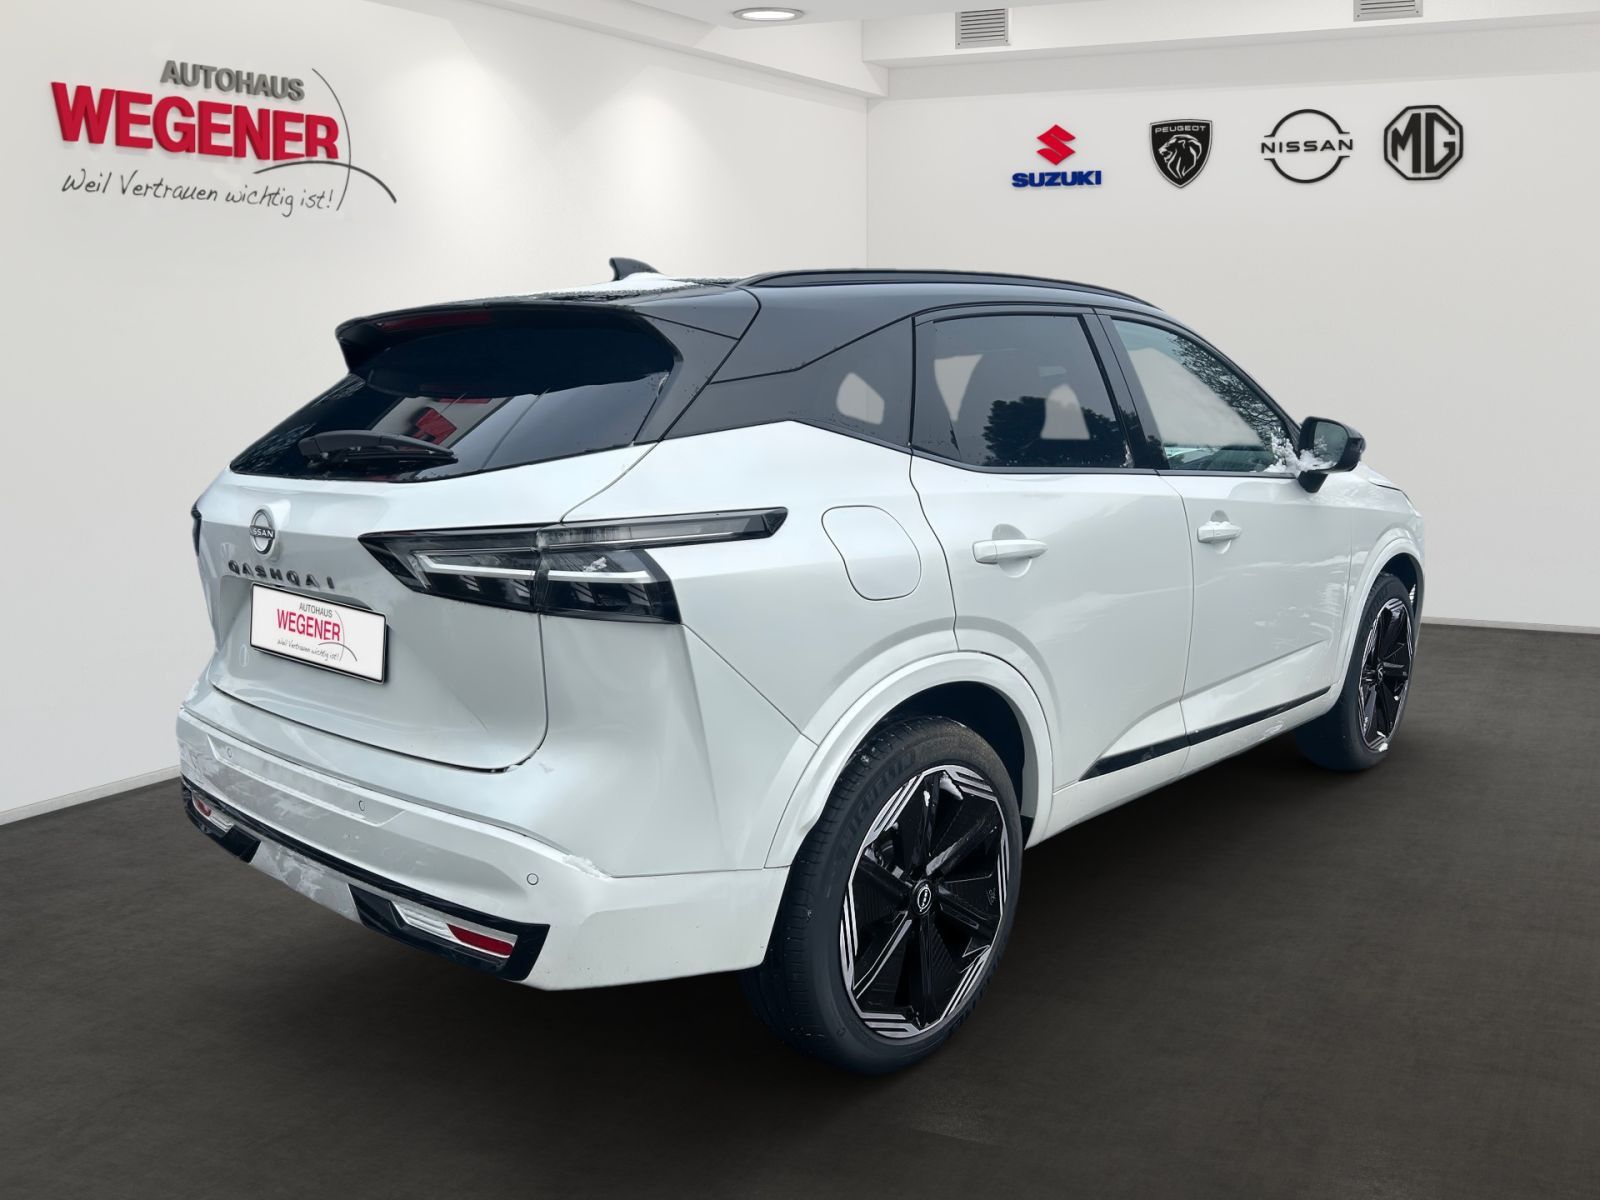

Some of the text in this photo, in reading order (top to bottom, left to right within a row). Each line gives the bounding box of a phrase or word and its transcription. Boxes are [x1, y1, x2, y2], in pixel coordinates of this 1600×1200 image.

[160, 60, 305, 101] AUTOHAUS
[51, 82, 340, 161] WEGENER
[1154, 124, 1207, 133] PEUGEOT
[1261, 138, 1354, 154] NISSAN
[1390, 112, 1457, 174] MG
[61, 168, 334, 218] Weil Vertrauen wichtig ist!
[1012, 170, 1102, 188] SUZUKI
[228, 560, 335, 589] QASHQAI
[276, 608, 341, 641] WEGENER
[299, 602, 333, 618] AUTOHAUS
